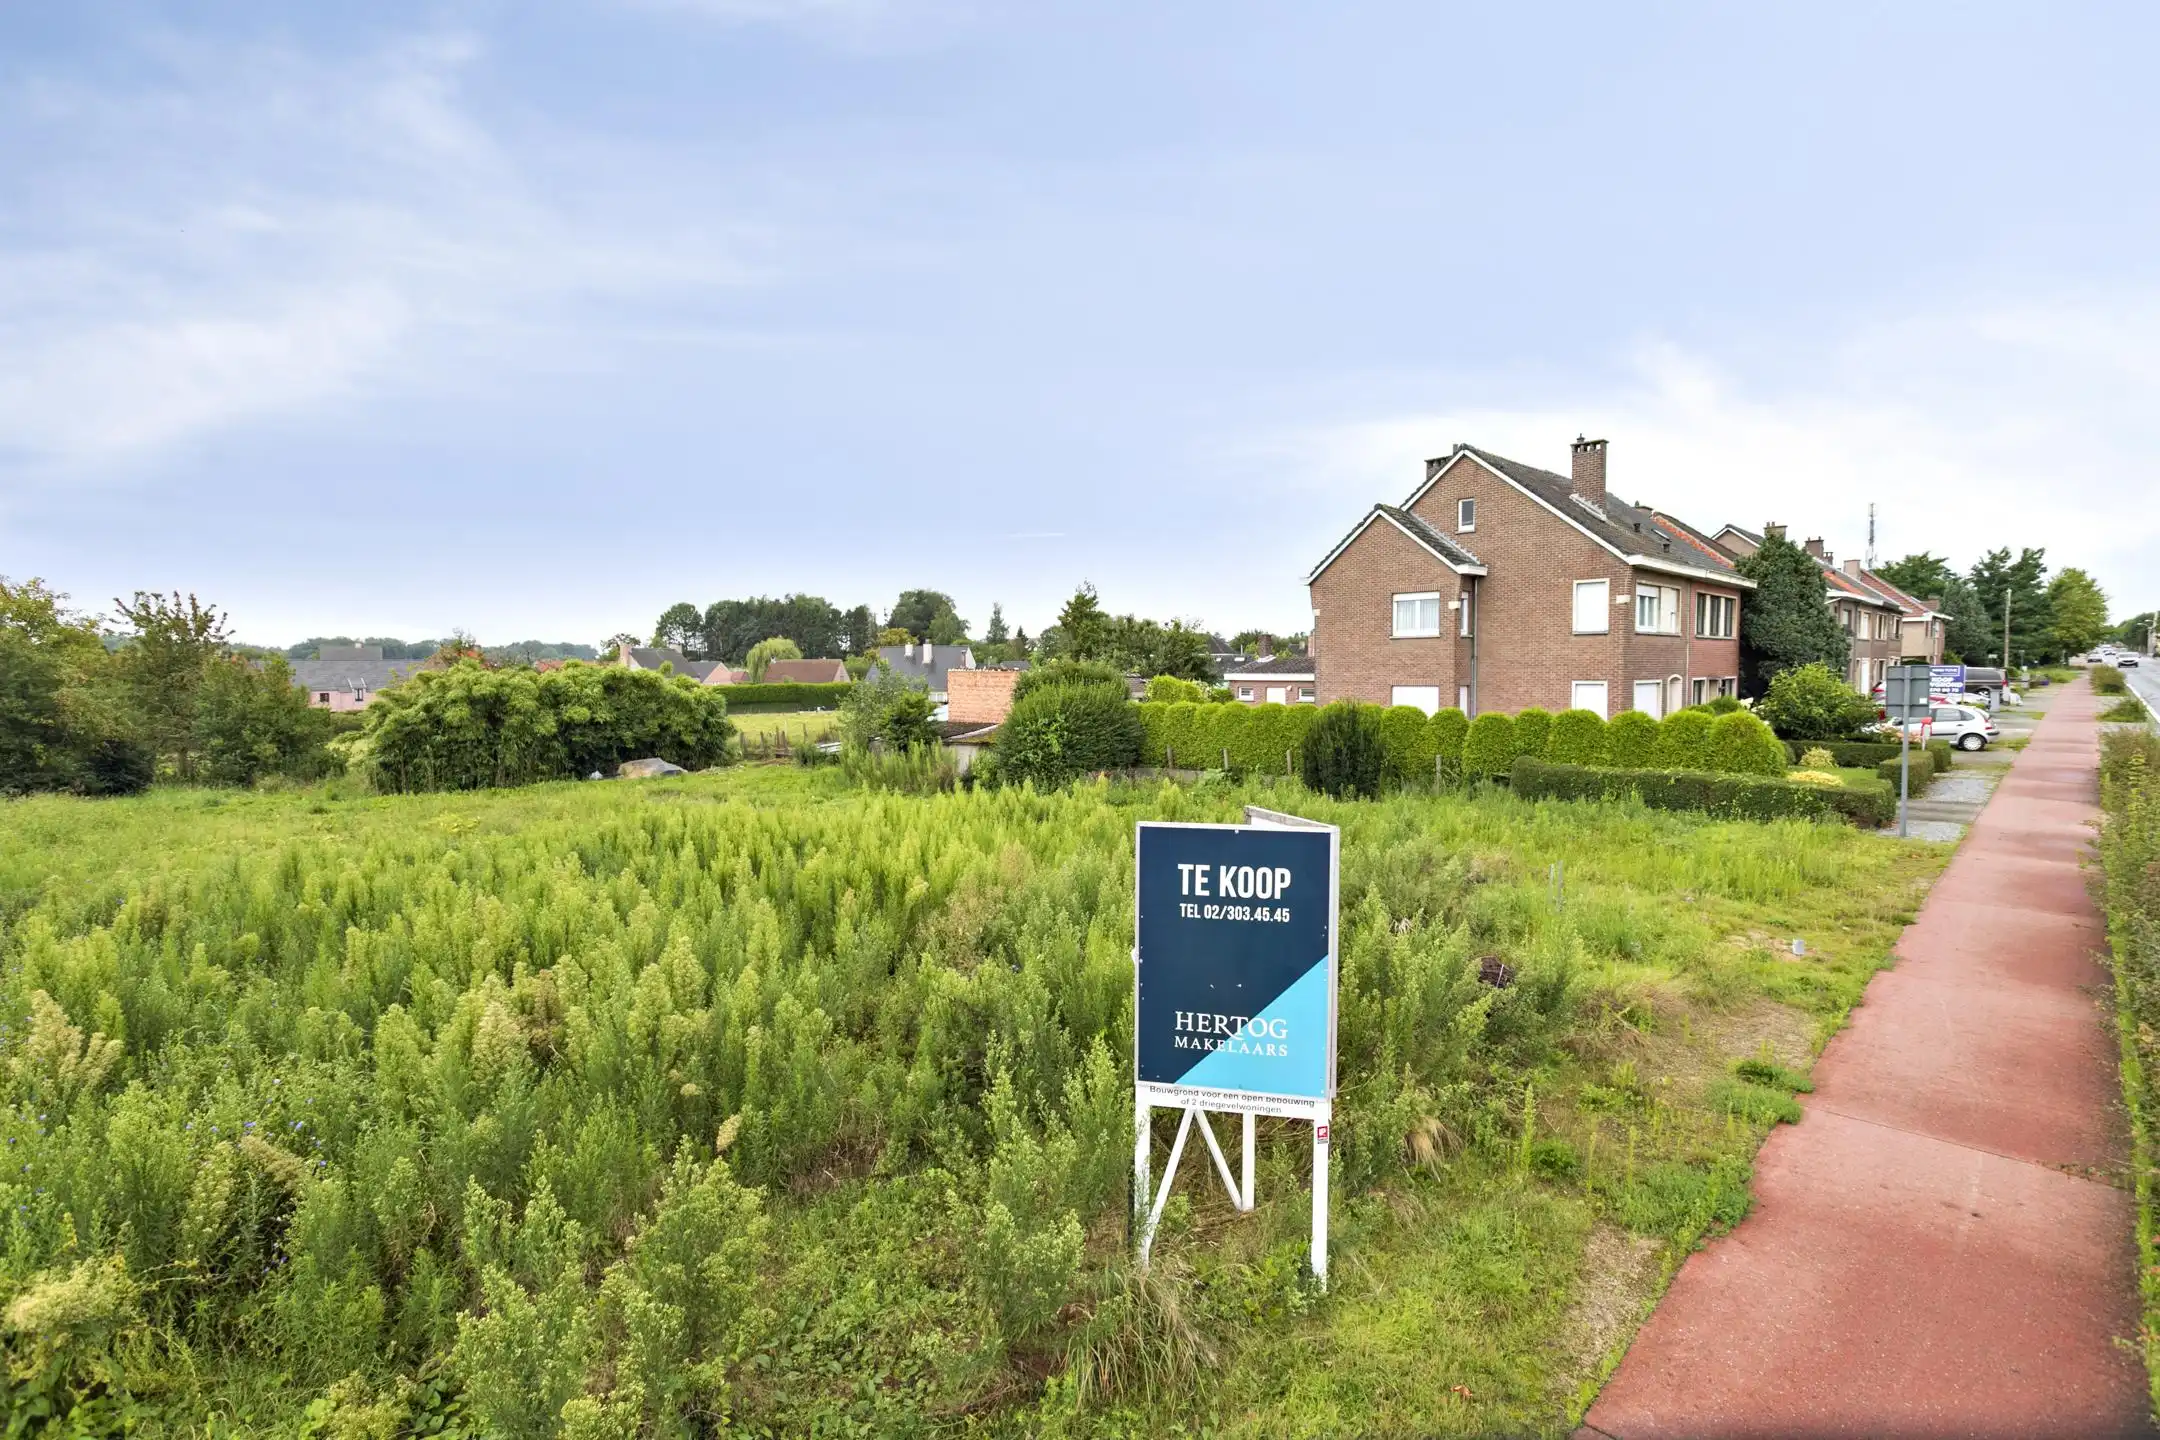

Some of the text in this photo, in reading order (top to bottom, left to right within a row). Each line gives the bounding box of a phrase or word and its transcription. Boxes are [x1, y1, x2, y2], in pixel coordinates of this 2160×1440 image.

[1177, 863, 1291, 900] TE KOOP
[1179, 902, 1291, 923] TEL 02/303.45.45
[1174, 1010, 1289, 1041] HERTOG
[1174, 1035, 1289, 1057] MAKELAARS
[1149, 1085, 1199, 1097] Bouwgrond
[1201, 1090, 1221, 1098] voor
[1223, 1092, 1239, 1100] een
[1241, 1093, 1263, 1103] open
[1199, 1100, 1282, 1114] driegevelwoningen
